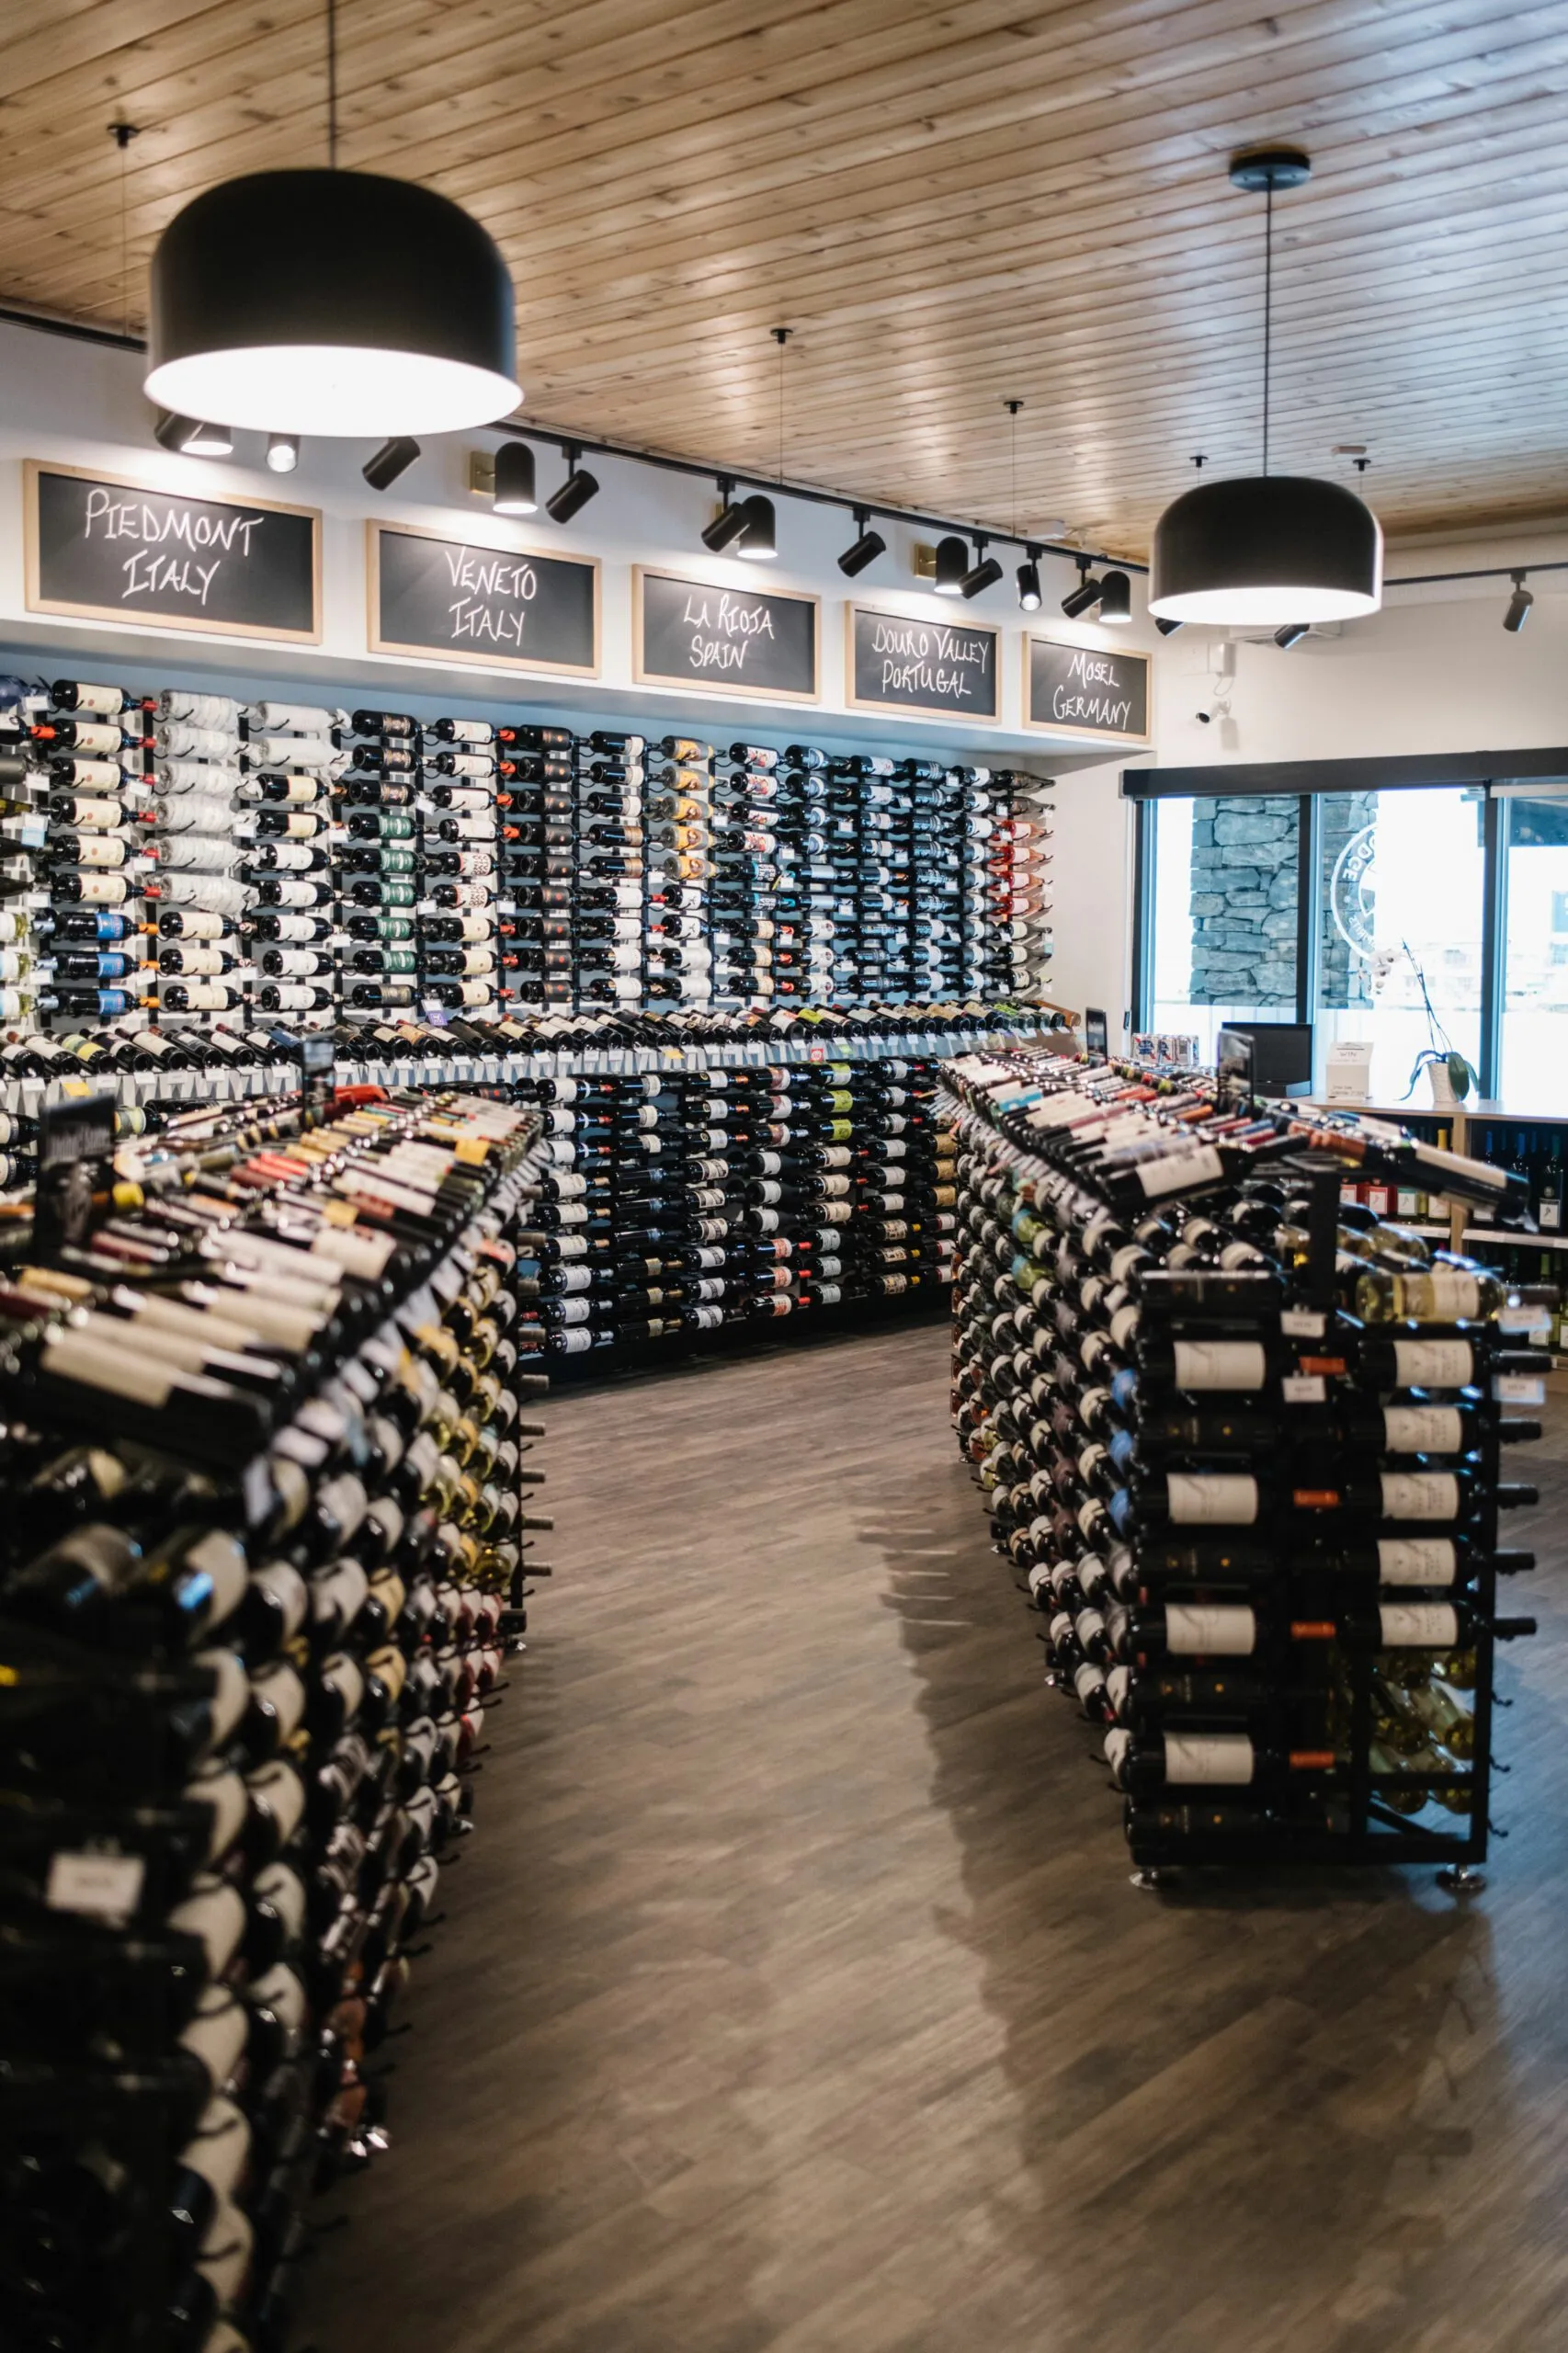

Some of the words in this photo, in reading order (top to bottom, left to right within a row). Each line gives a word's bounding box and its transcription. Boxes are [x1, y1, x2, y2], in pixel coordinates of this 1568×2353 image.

[85, 488, 265, 557] PIEDMONT
[121, 549, 221, 606] ITALY
[445, 545, 537, 600] VENETO
[449, 597, 525, 647] ITALY
[683, 595, 710, 629] LA
[718, 593, 775, 640] RIOJA
[689, 634, 748, 669] SPAIN
[871, 623, 929, 658] DOURO
[933, 628, 989, 674] VALLEY
[1067, 653, 1120, 689] MOSEL
[882, 659, 972, 699] PORTUGAL
[1052, 685, 1131, 731] GERMANY
